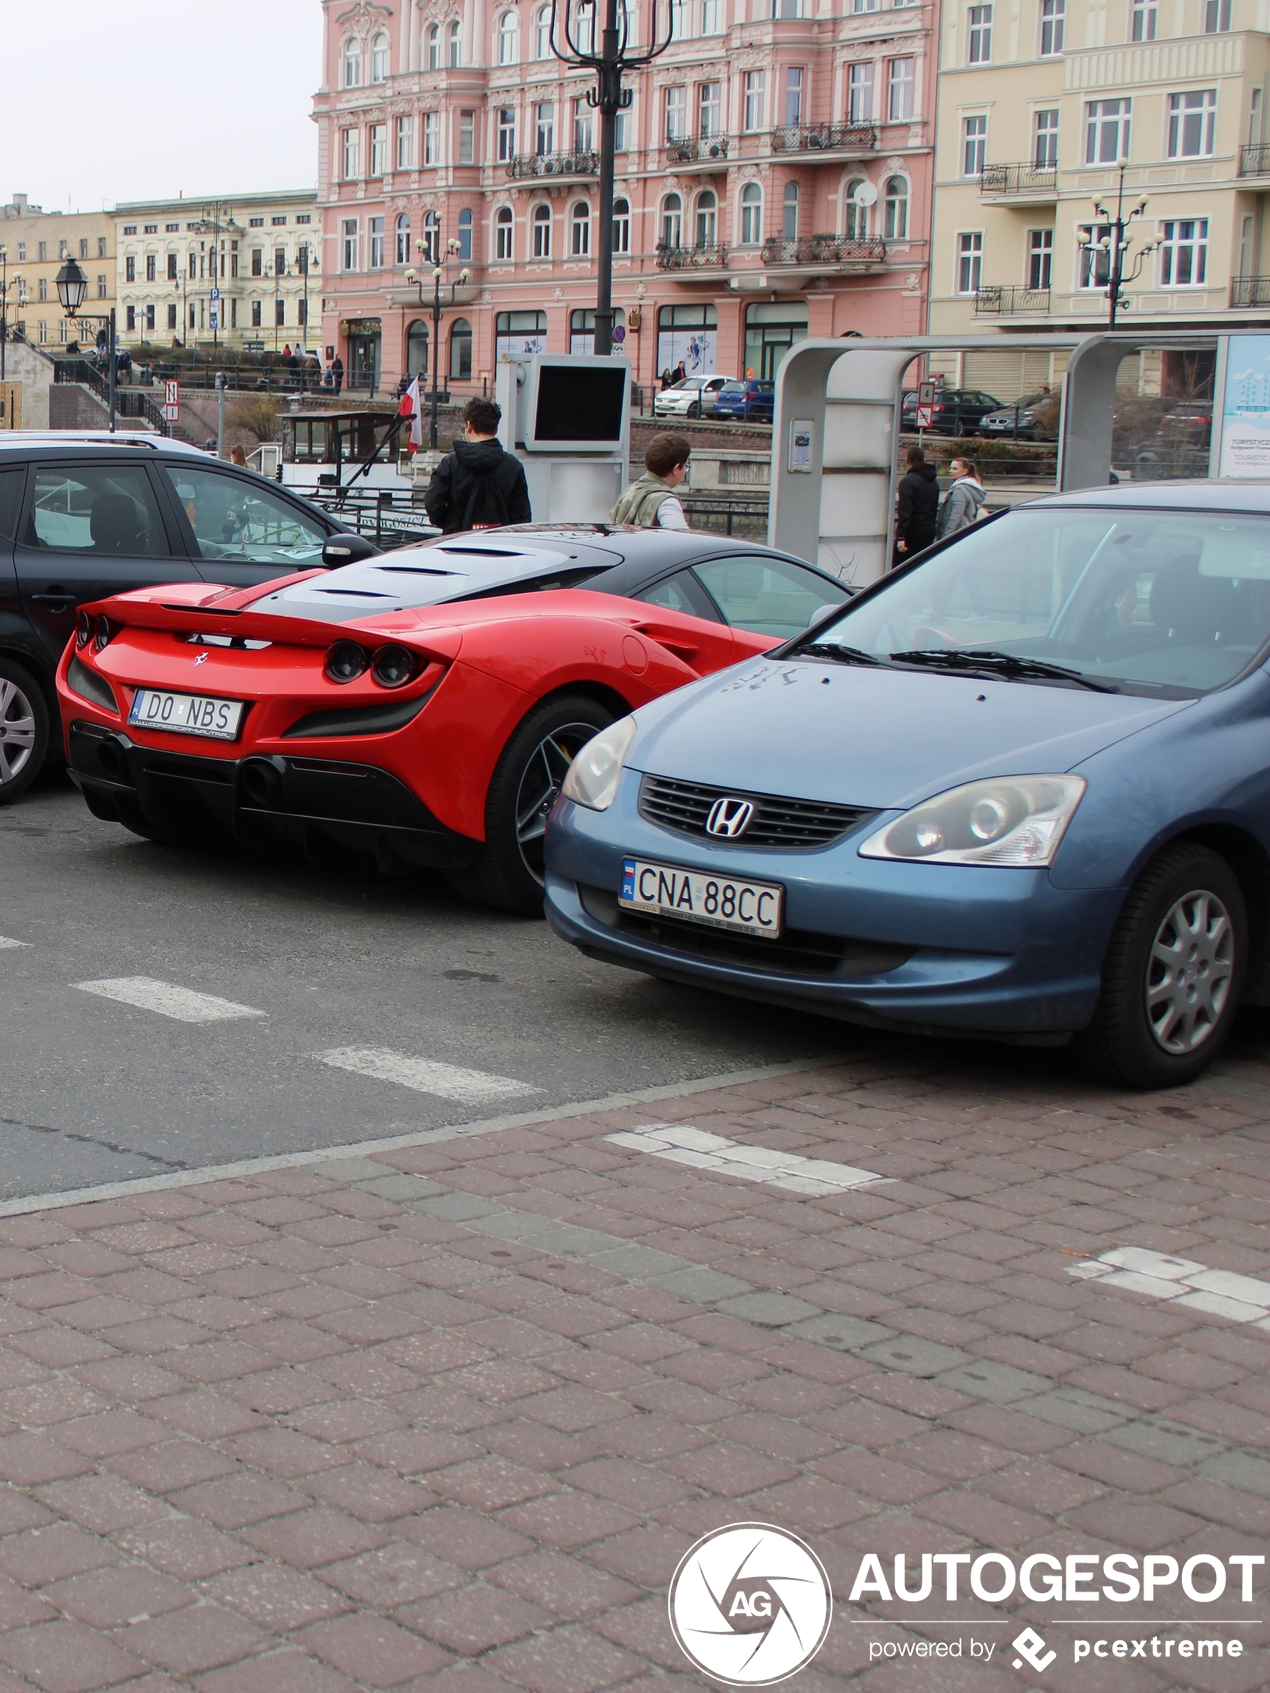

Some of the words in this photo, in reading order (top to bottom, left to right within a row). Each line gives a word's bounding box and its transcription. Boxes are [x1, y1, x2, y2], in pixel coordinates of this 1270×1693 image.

[924, 390, 930, 398] 4
[186, 699, 231, 729] NBS
[623, 884, 633, 895] PL
[639, 868, 693, 910] CNA
[704, 881, 775, 926] 88CC
[628, 902, 658, 914] HONDA
